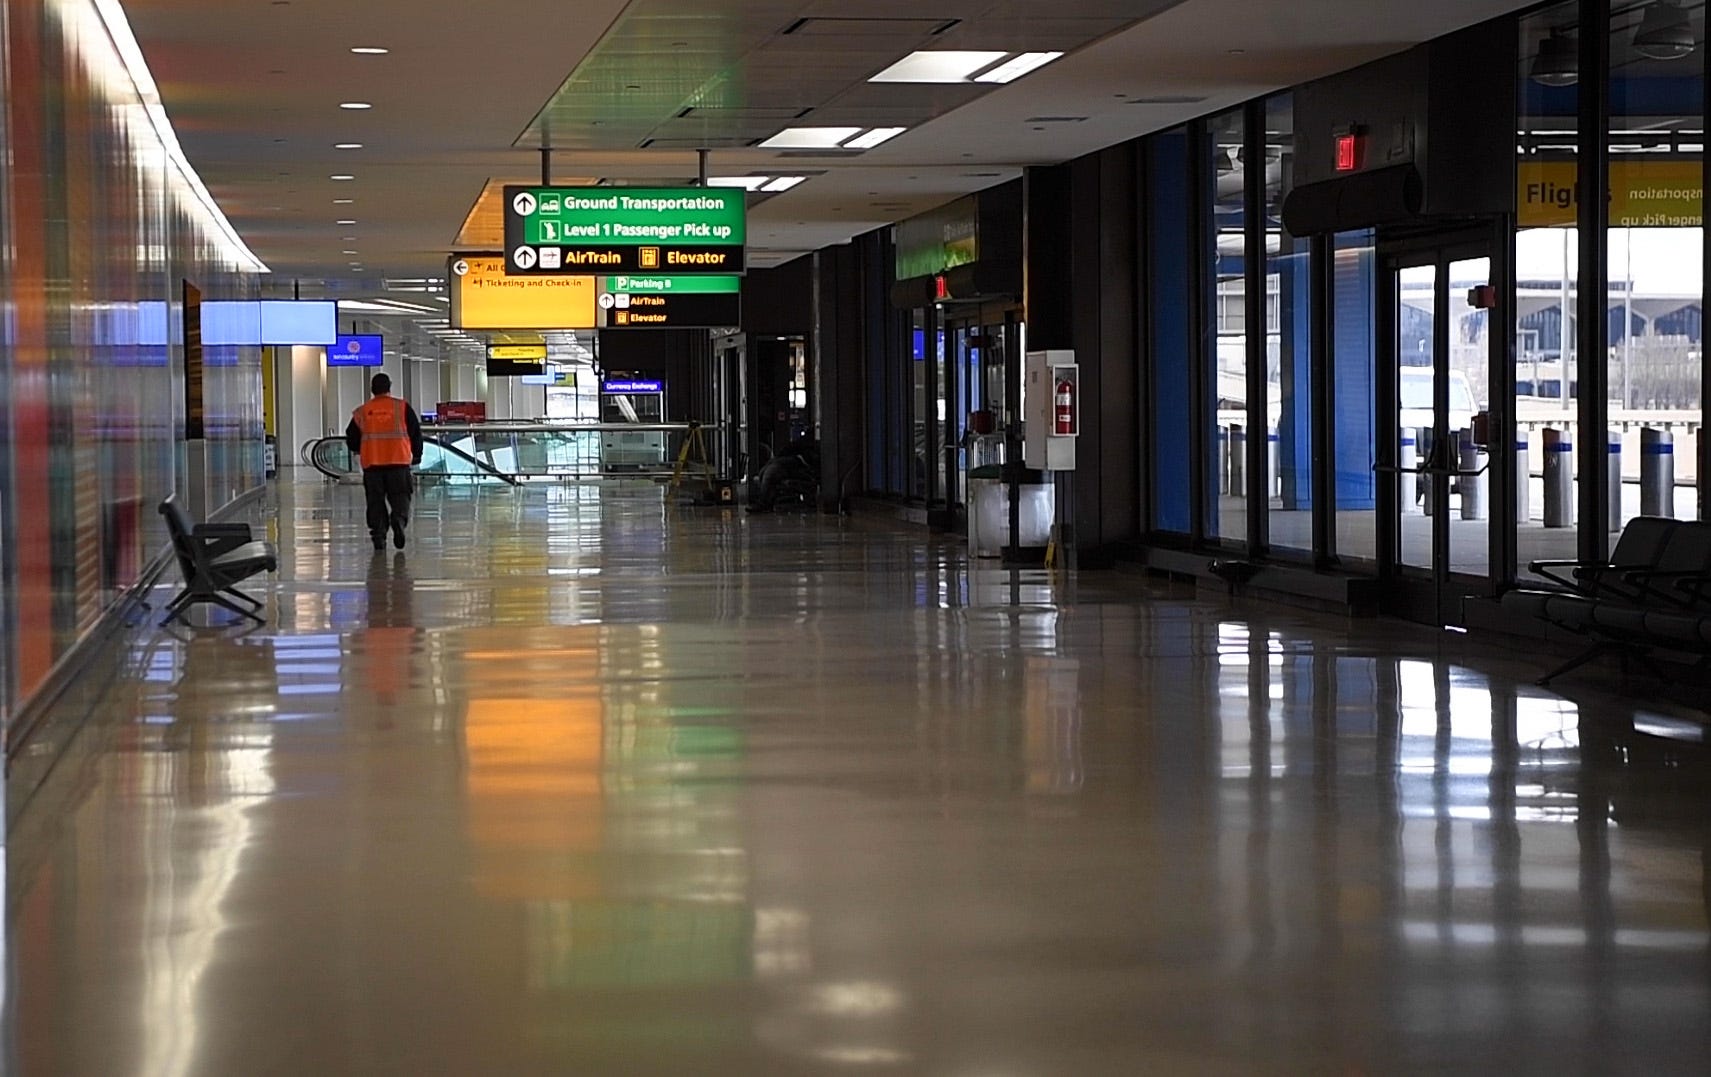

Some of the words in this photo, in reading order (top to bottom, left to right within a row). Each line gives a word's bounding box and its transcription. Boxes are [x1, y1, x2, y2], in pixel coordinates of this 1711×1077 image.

[1527, 181, 1612, 209] Flig
[564, 196, 617, 211] Ground
[621, 196, 725, 212] Transportation
[564, 223, 600, 237] Level
[603, 223, 610, 236] 1
[613, 223, 682, 239] Passenger
[683, 223, 711, 236] Pick
[712, 225, 732, 239] up
[565, 250, 622, 264] AirTrain
[667, 250, 726, 264] Elevator
[486, 264, 498, 273] All
[486, 279, 525, 289] Ticketing
[527, 278, 543, 288] and
[545, 278, 582, 288] Check-in
[629, 278, 664, 290] Parking
[630, 295, 666, 306] AirTrain
[630, 313, 667, 323] Elevator
